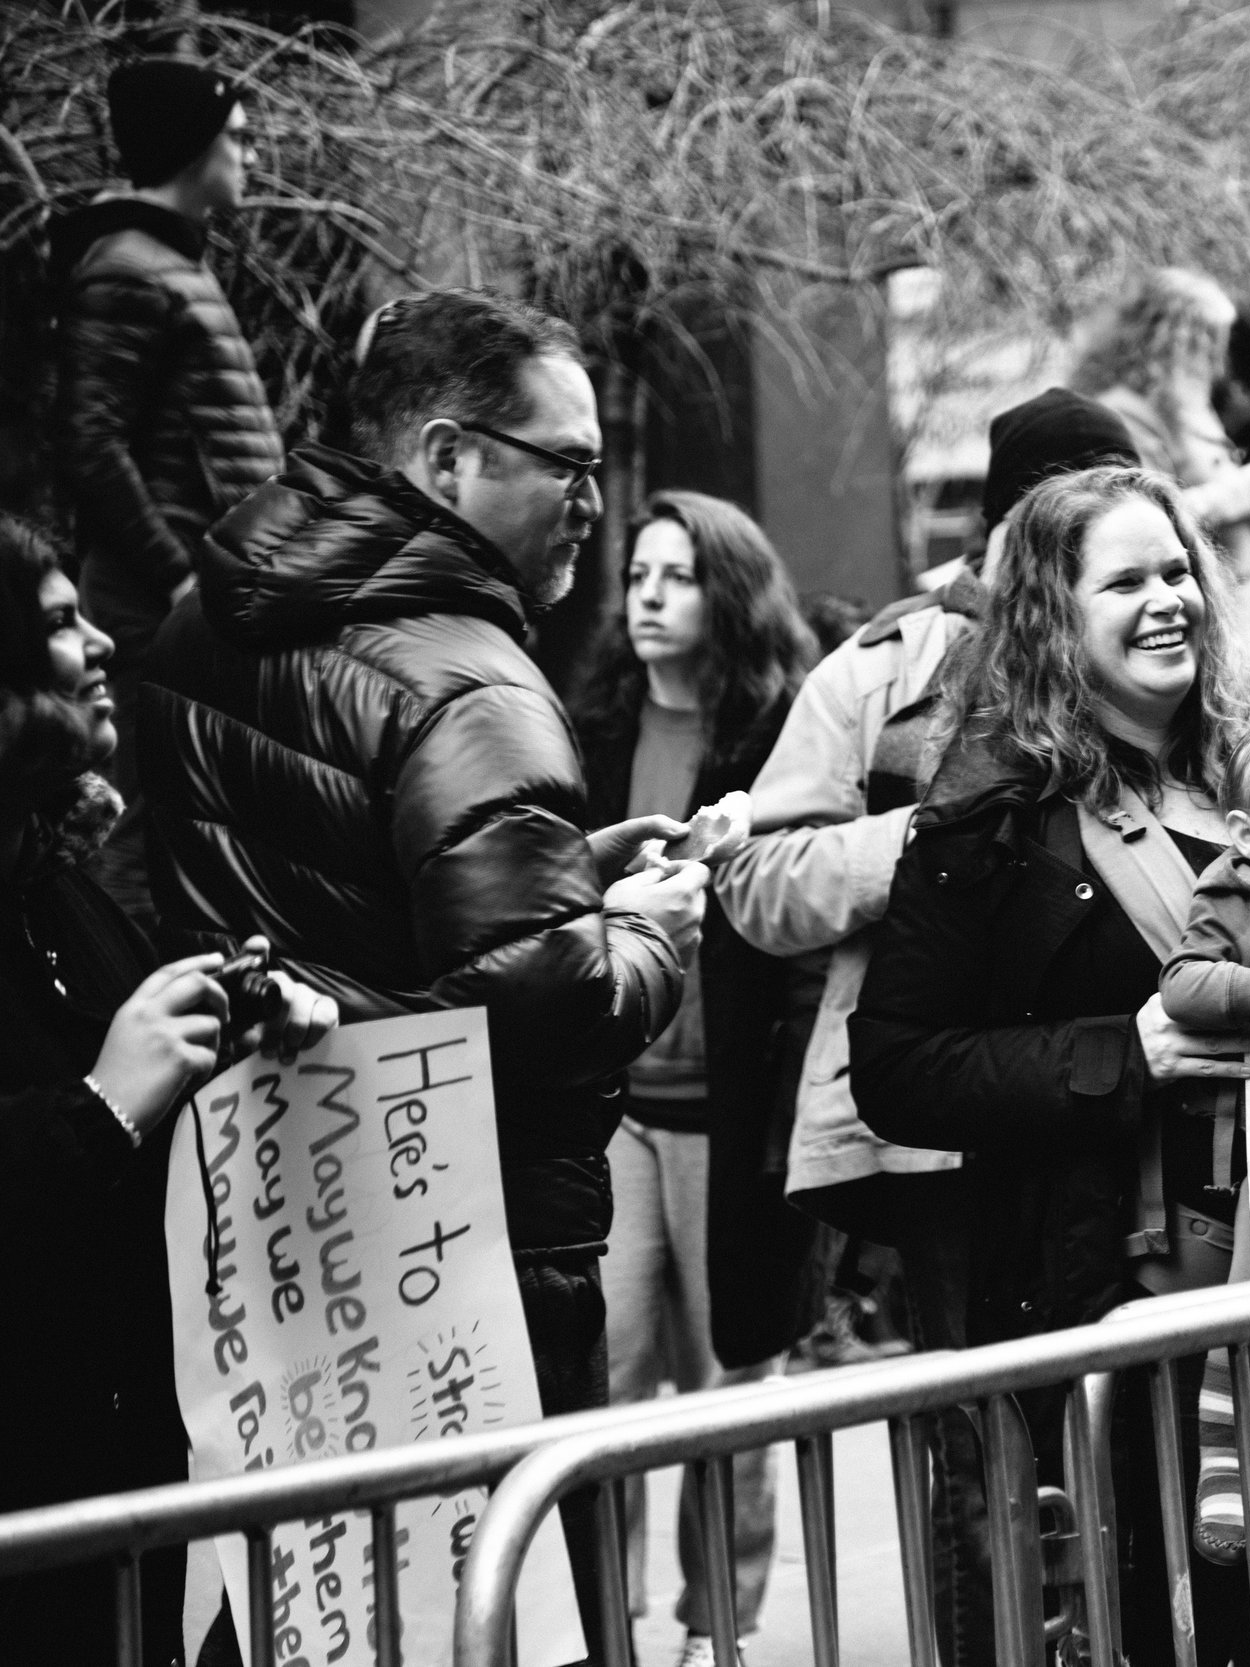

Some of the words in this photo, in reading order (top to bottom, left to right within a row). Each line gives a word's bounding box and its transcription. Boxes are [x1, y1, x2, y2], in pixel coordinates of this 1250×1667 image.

[252, 1073, 289, 1220] May
[297, 1063, 360, 1233] May
[377, 1037, 473, 1199] Here's
[267, 1224, 305, 1324] we
[319, 1229, 367, 1336] we
[399, 1221, 471, 1307] to
[288, 1370, 326, 1459] be
[337, 1336, 380, 1451] Kno
[273, 1545, 311, 1667] the
